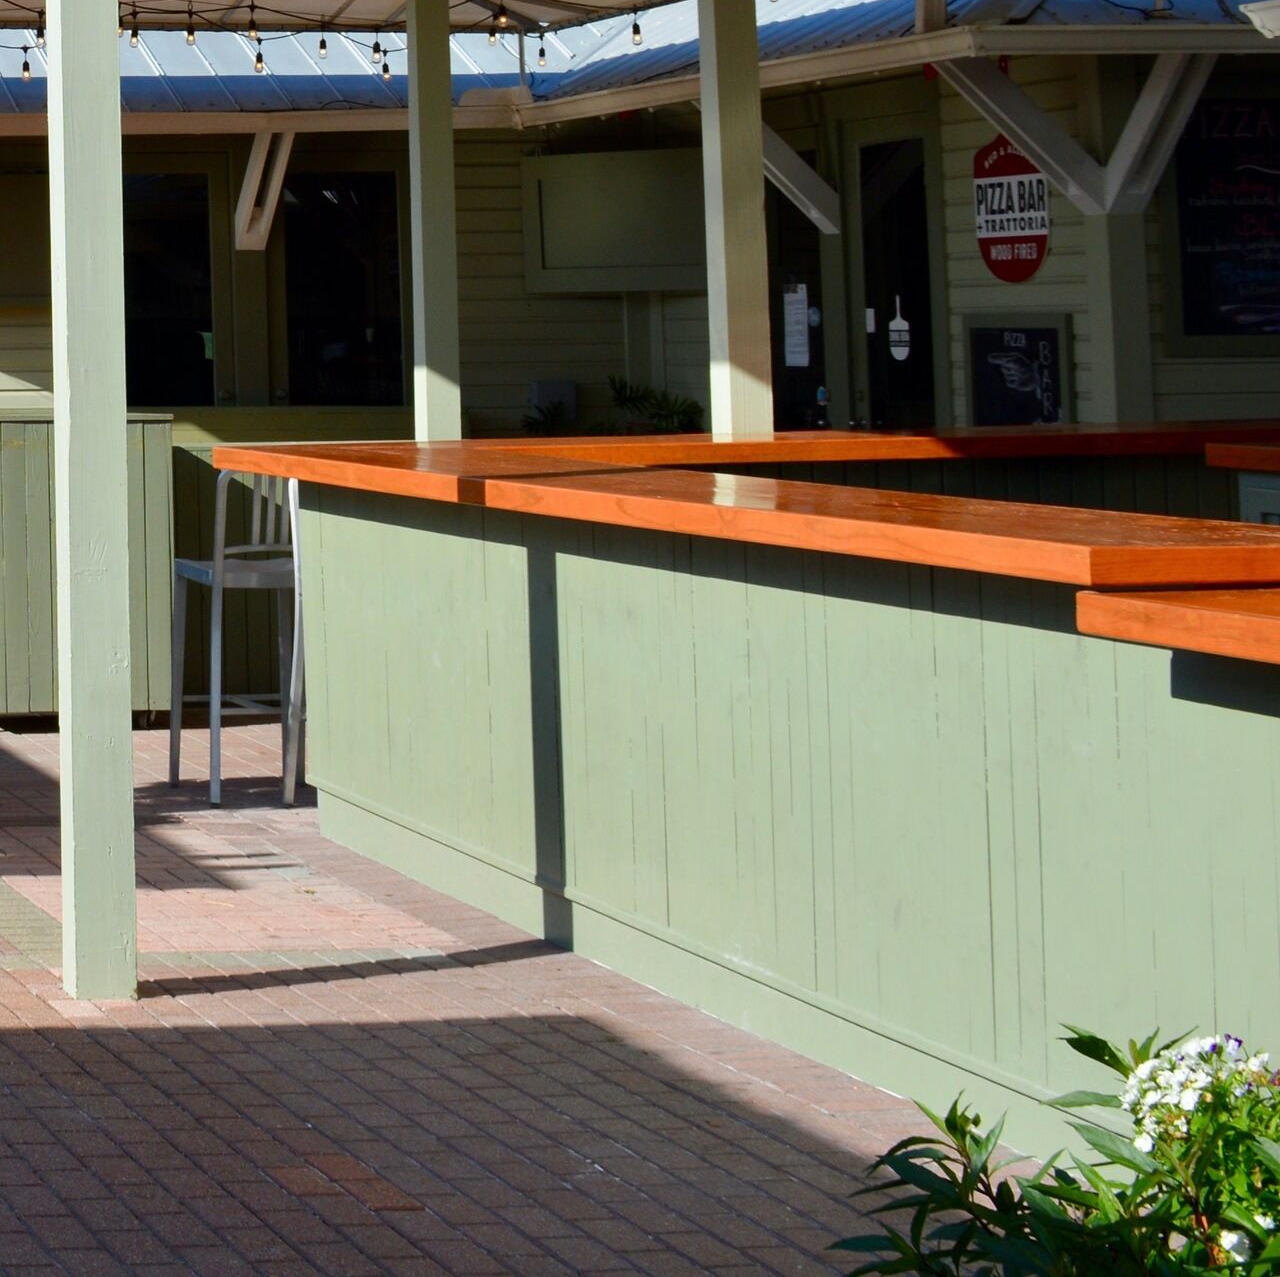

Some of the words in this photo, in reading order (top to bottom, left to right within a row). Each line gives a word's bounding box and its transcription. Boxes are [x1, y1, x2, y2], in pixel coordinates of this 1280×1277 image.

[1183, 105, 1278, 139] IZZA
[976, 181, 1015, 216] PIZZA
[1018, 179, 1046, 214] BAR
[990, 244, 1012, 261] WOOD
[1014, 242, 1038, 260] FIRED
